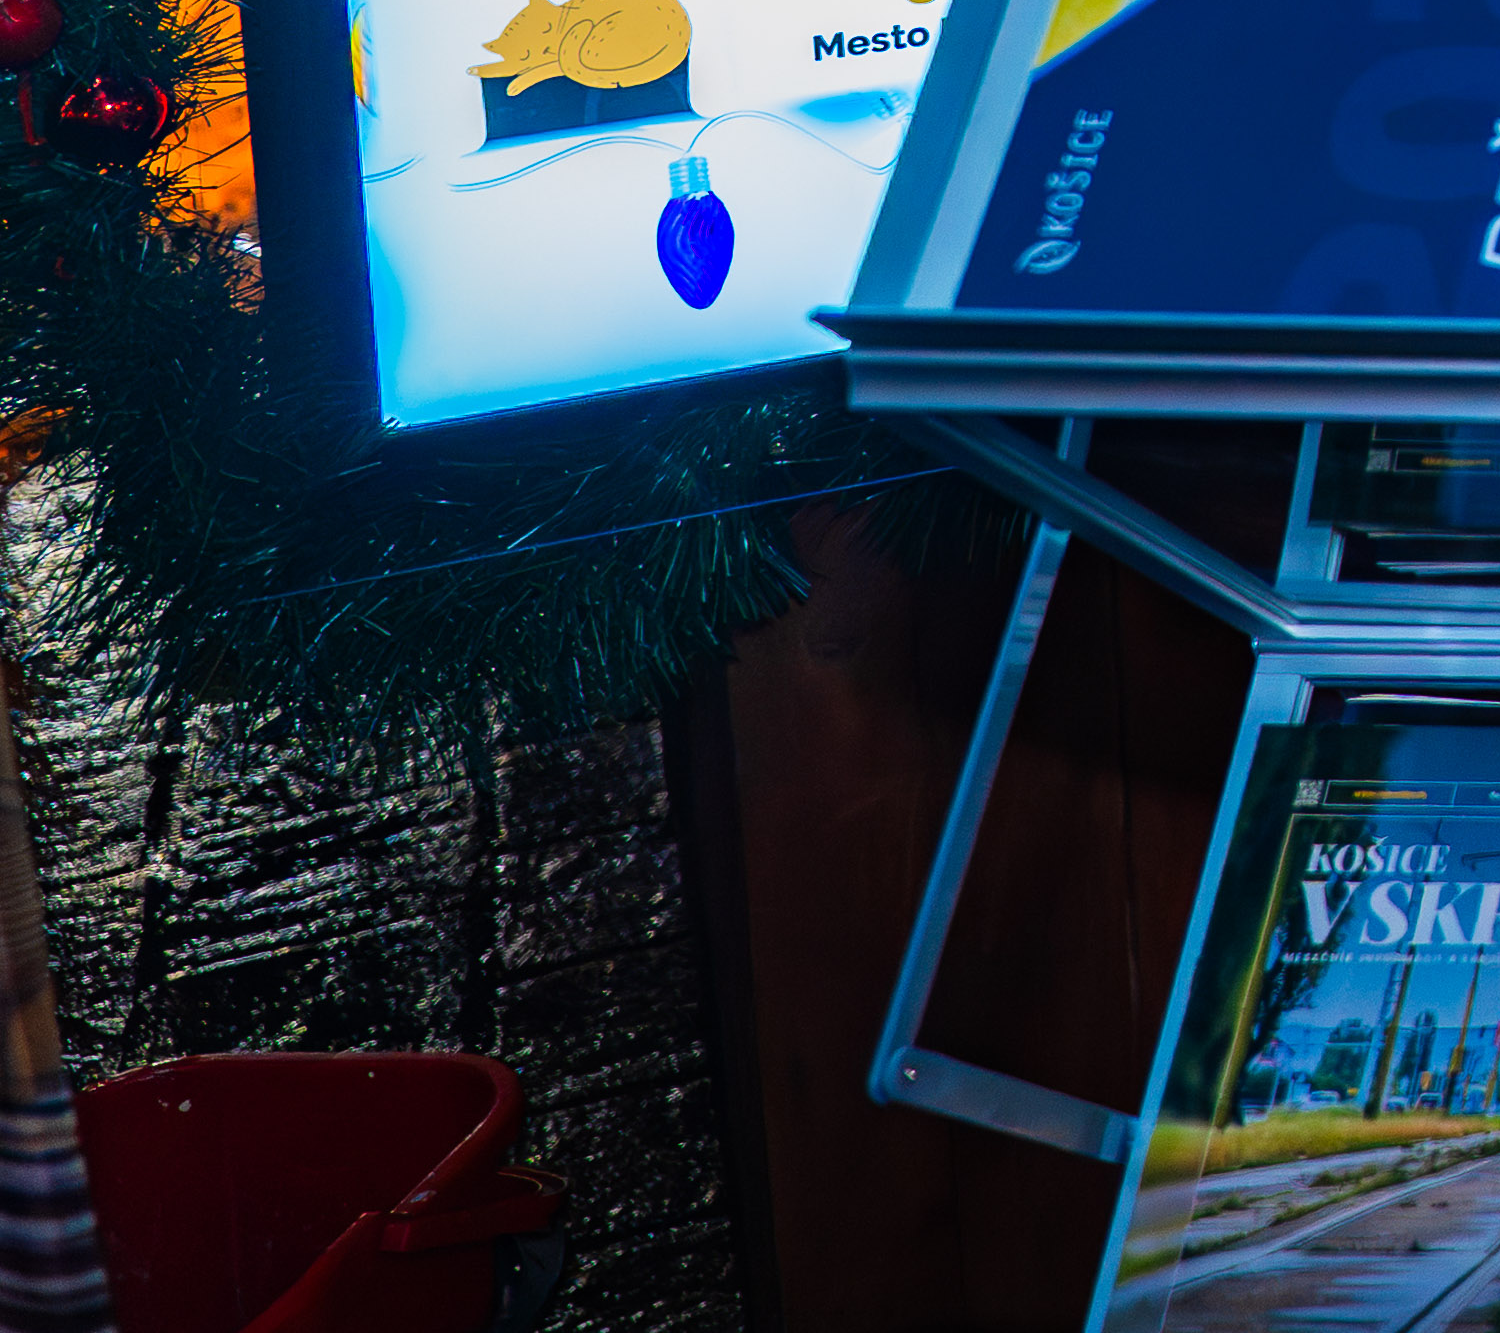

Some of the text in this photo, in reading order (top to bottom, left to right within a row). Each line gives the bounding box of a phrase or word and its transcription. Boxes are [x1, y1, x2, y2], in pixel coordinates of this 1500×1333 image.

[812, 24, 930, 62] Mesto
[1036, 108, 1114, 237] KOŠICE
[1305, 835, 1452, 874] KOŠICE
[1301, 879, 1363, 947] V
